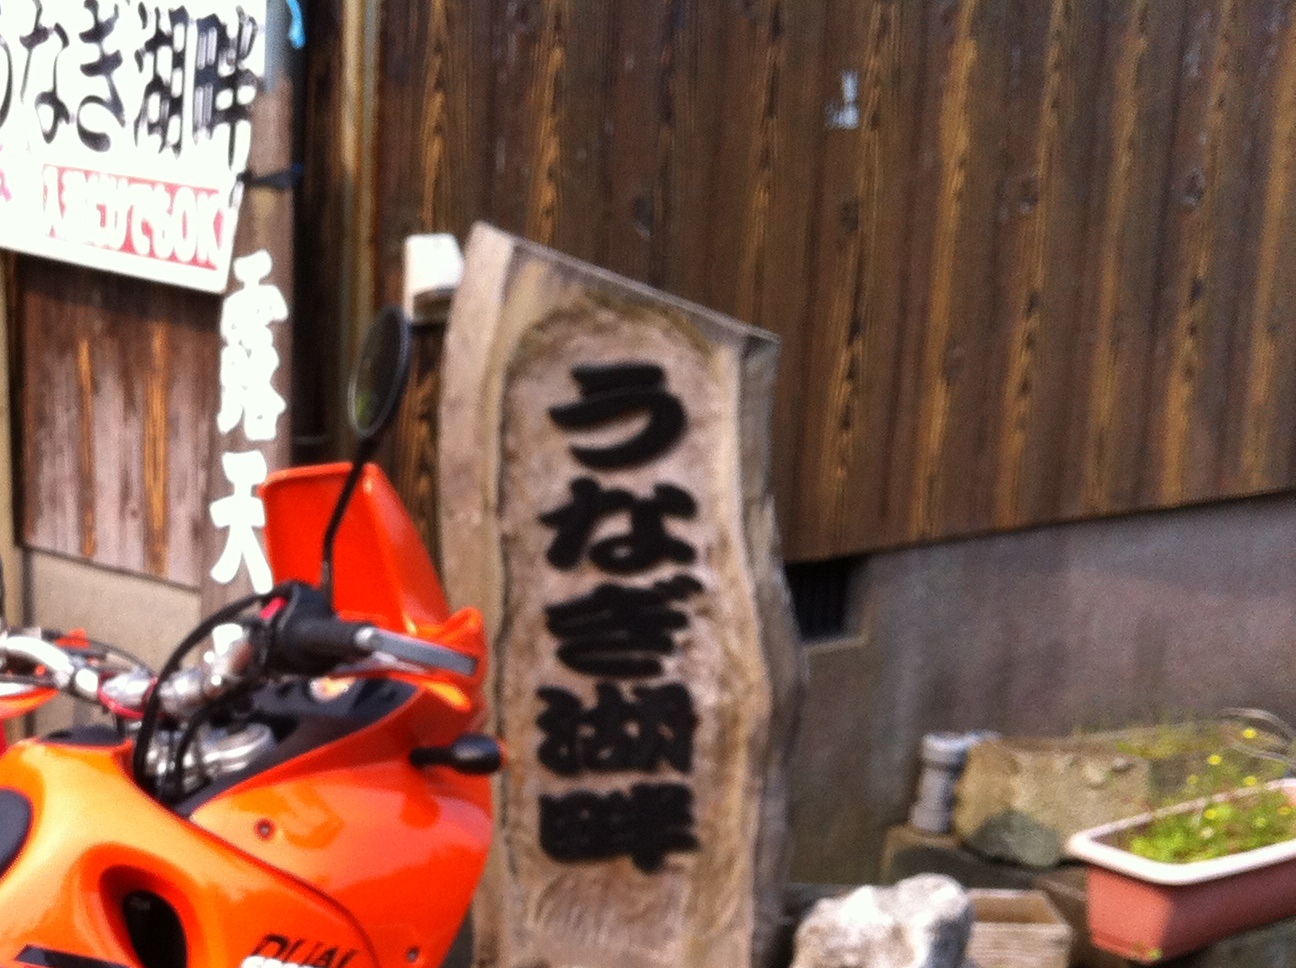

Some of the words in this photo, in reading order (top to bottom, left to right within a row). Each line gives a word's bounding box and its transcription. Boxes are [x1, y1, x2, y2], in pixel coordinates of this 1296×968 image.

[538, 361, 705, 874] うなぎ湖畔
